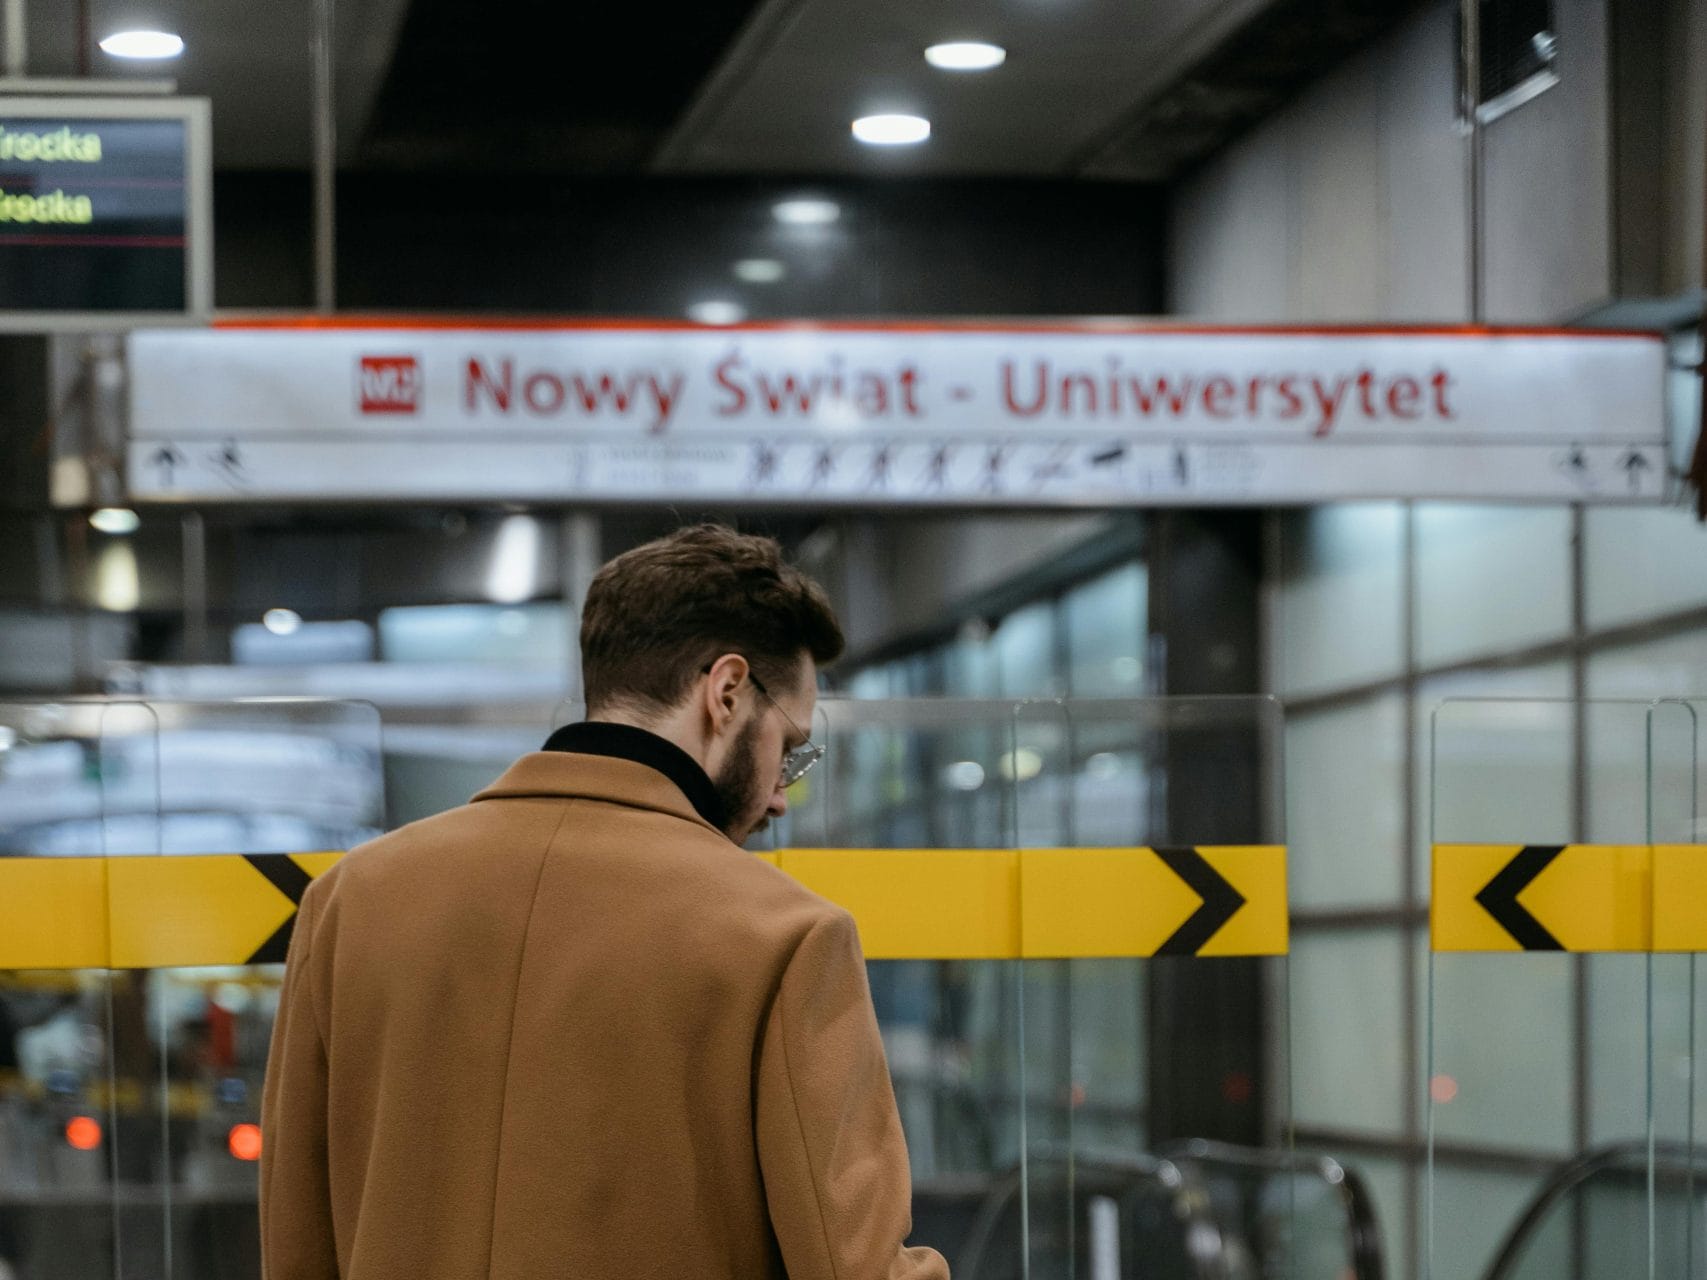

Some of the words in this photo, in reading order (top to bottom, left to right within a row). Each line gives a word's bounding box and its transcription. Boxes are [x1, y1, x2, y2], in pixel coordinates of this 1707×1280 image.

[0, 126, 101, 162] rocka
[0, 188, 93, 224] rocka
[465, 357, 687, 435] Nowy
[714, 345, 923, 418] Świat
[1000, 356, 1457, 438] Uniwersytet
